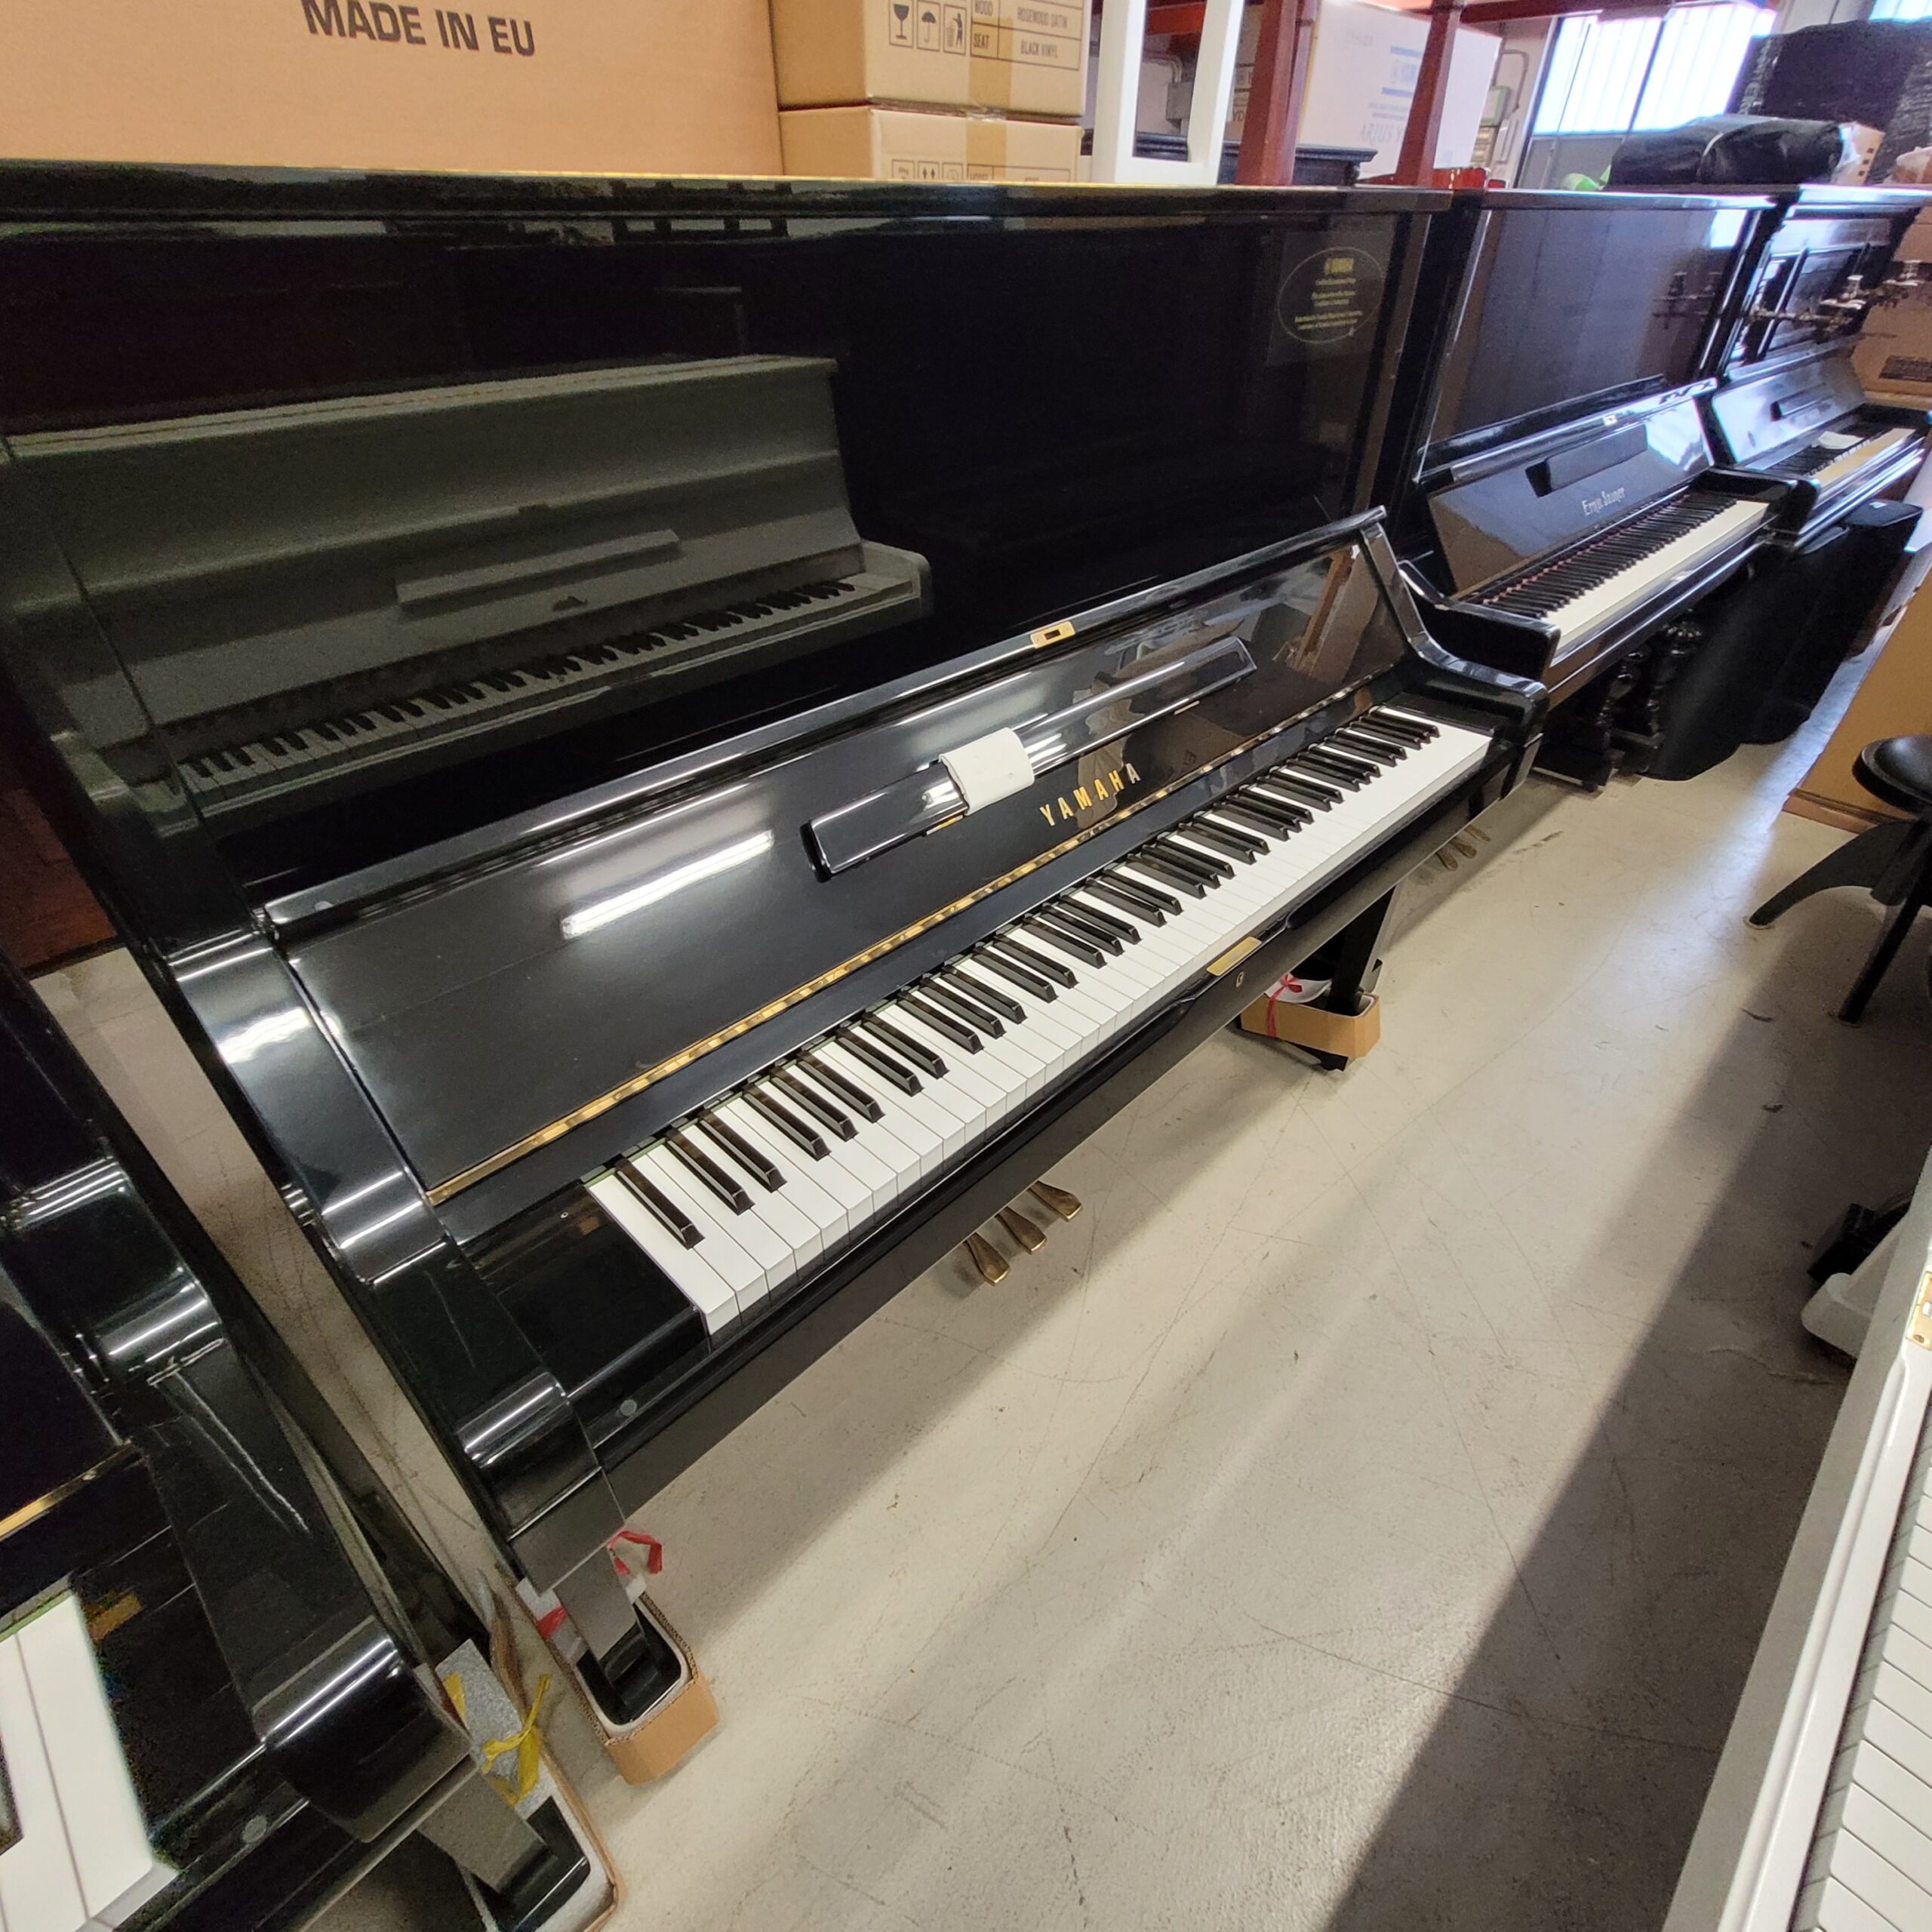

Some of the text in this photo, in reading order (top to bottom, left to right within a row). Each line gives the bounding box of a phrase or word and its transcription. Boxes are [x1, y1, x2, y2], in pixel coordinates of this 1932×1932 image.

[302, 0, 535, 57] MADE IN EU
[974, 33, 990, 50] SEAT
[1020, 40, 1039, 56] BLACK
[1039, 763, 1142, 826] YAMAHA
